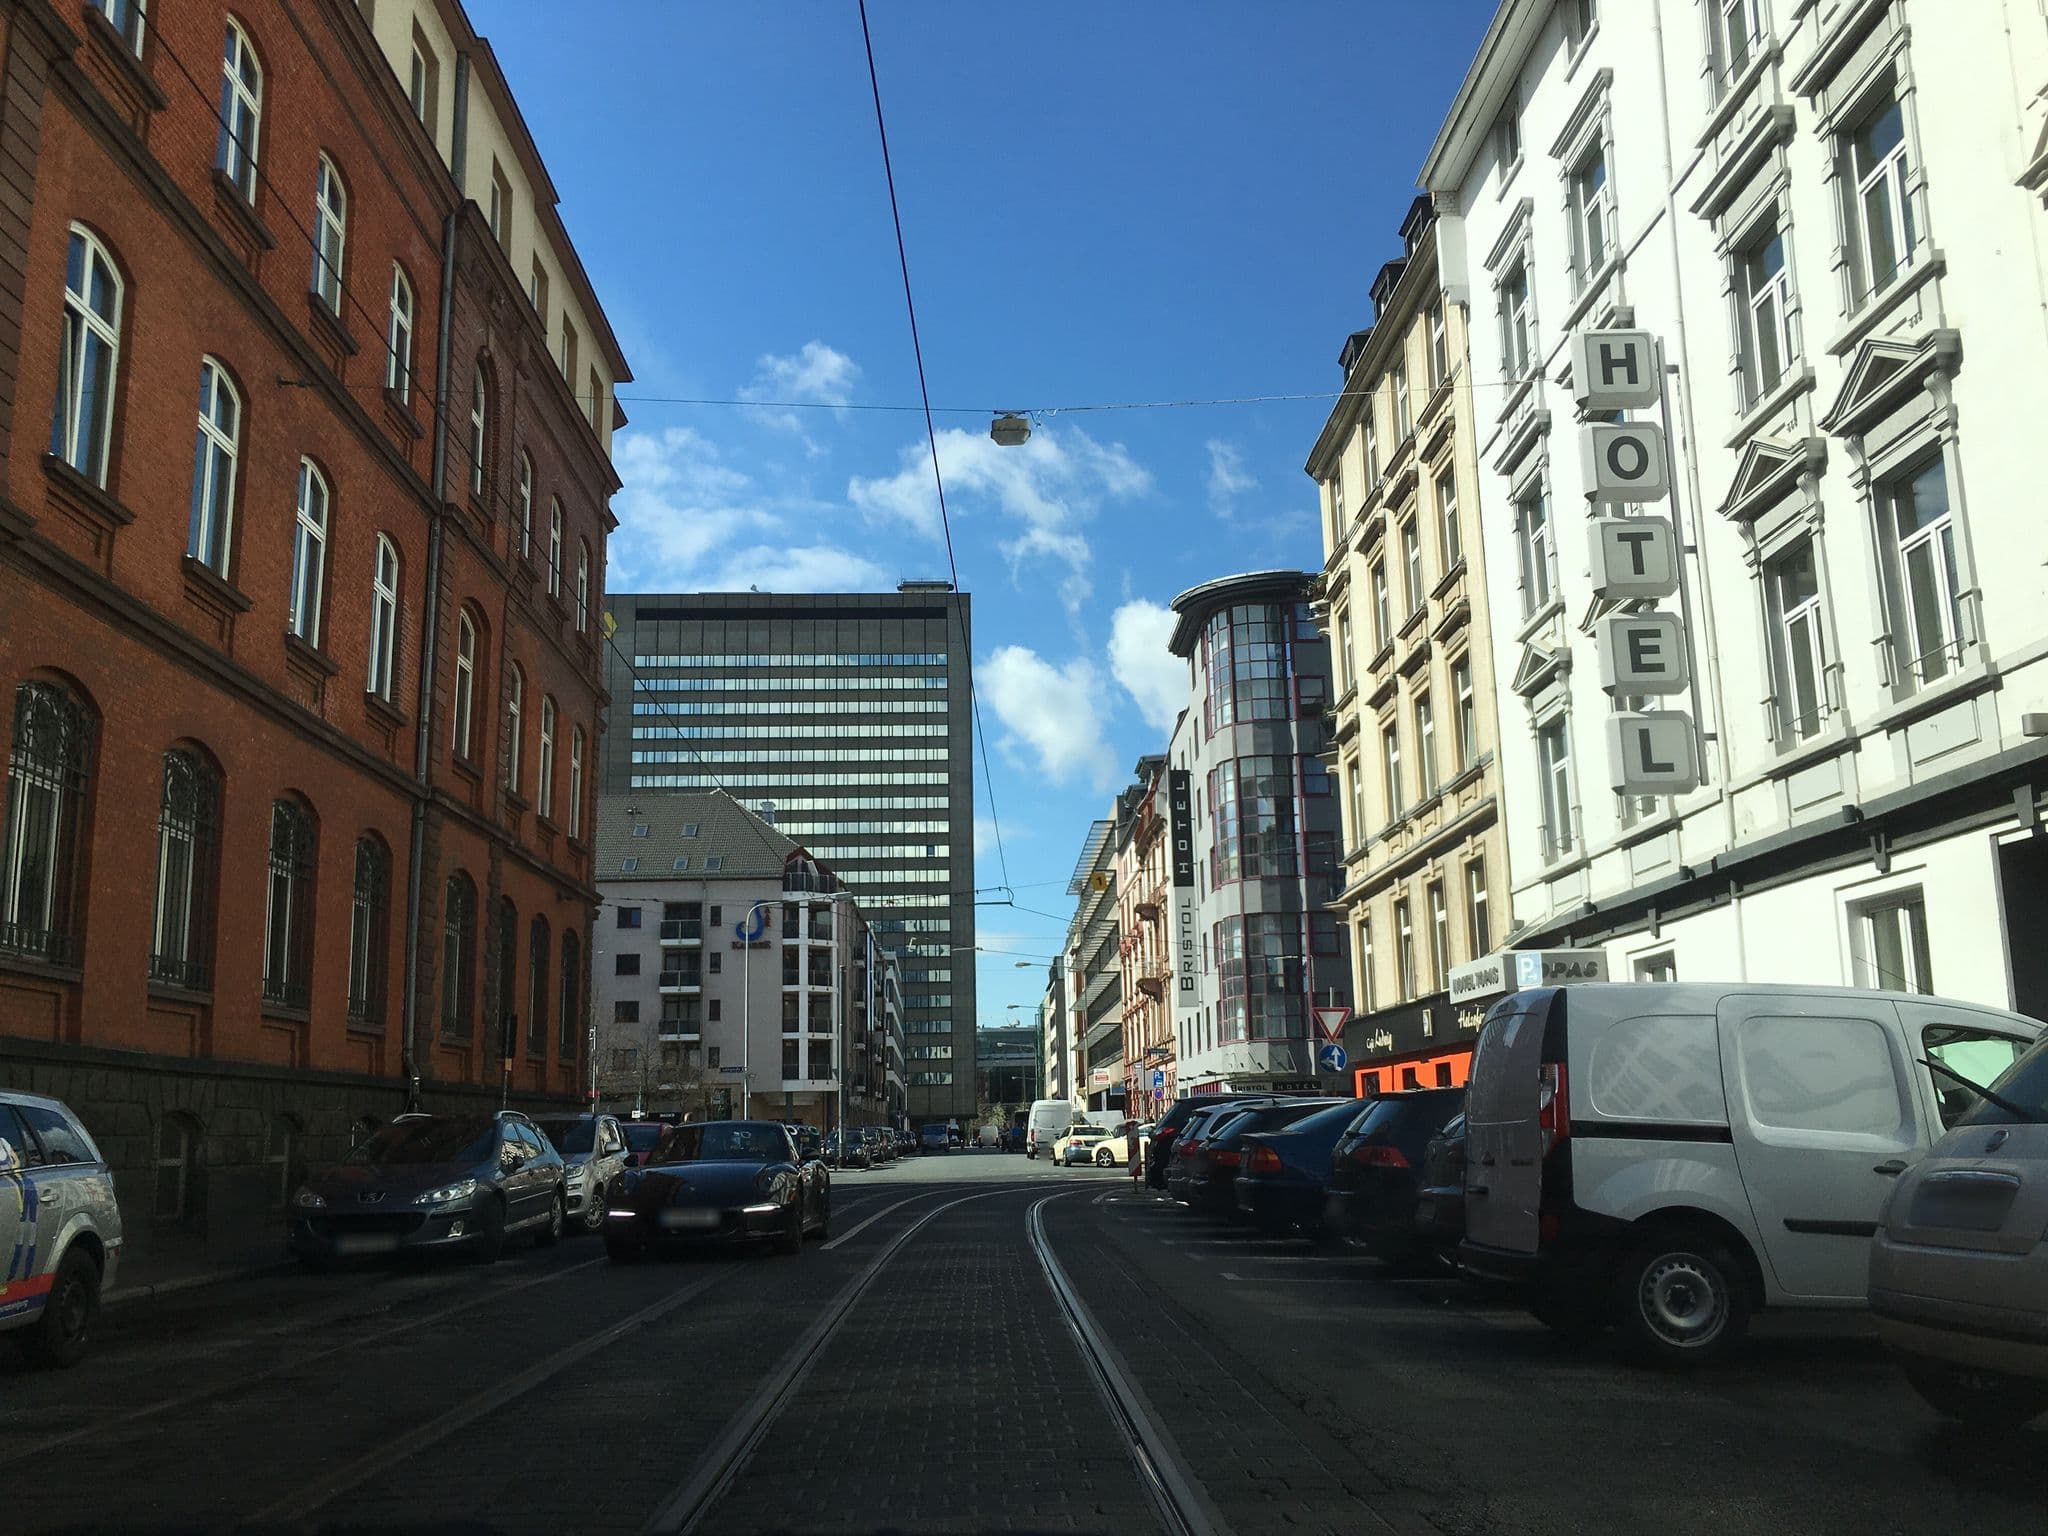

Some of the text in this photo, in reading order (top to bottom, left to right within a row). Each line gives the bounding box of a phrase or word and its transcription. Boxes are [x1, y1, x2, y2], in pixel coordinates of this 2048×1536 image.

[1600, 343, 1675, 774] HOTEL
[1176, 780, 1194, 992] BRISTOL HOTEL
